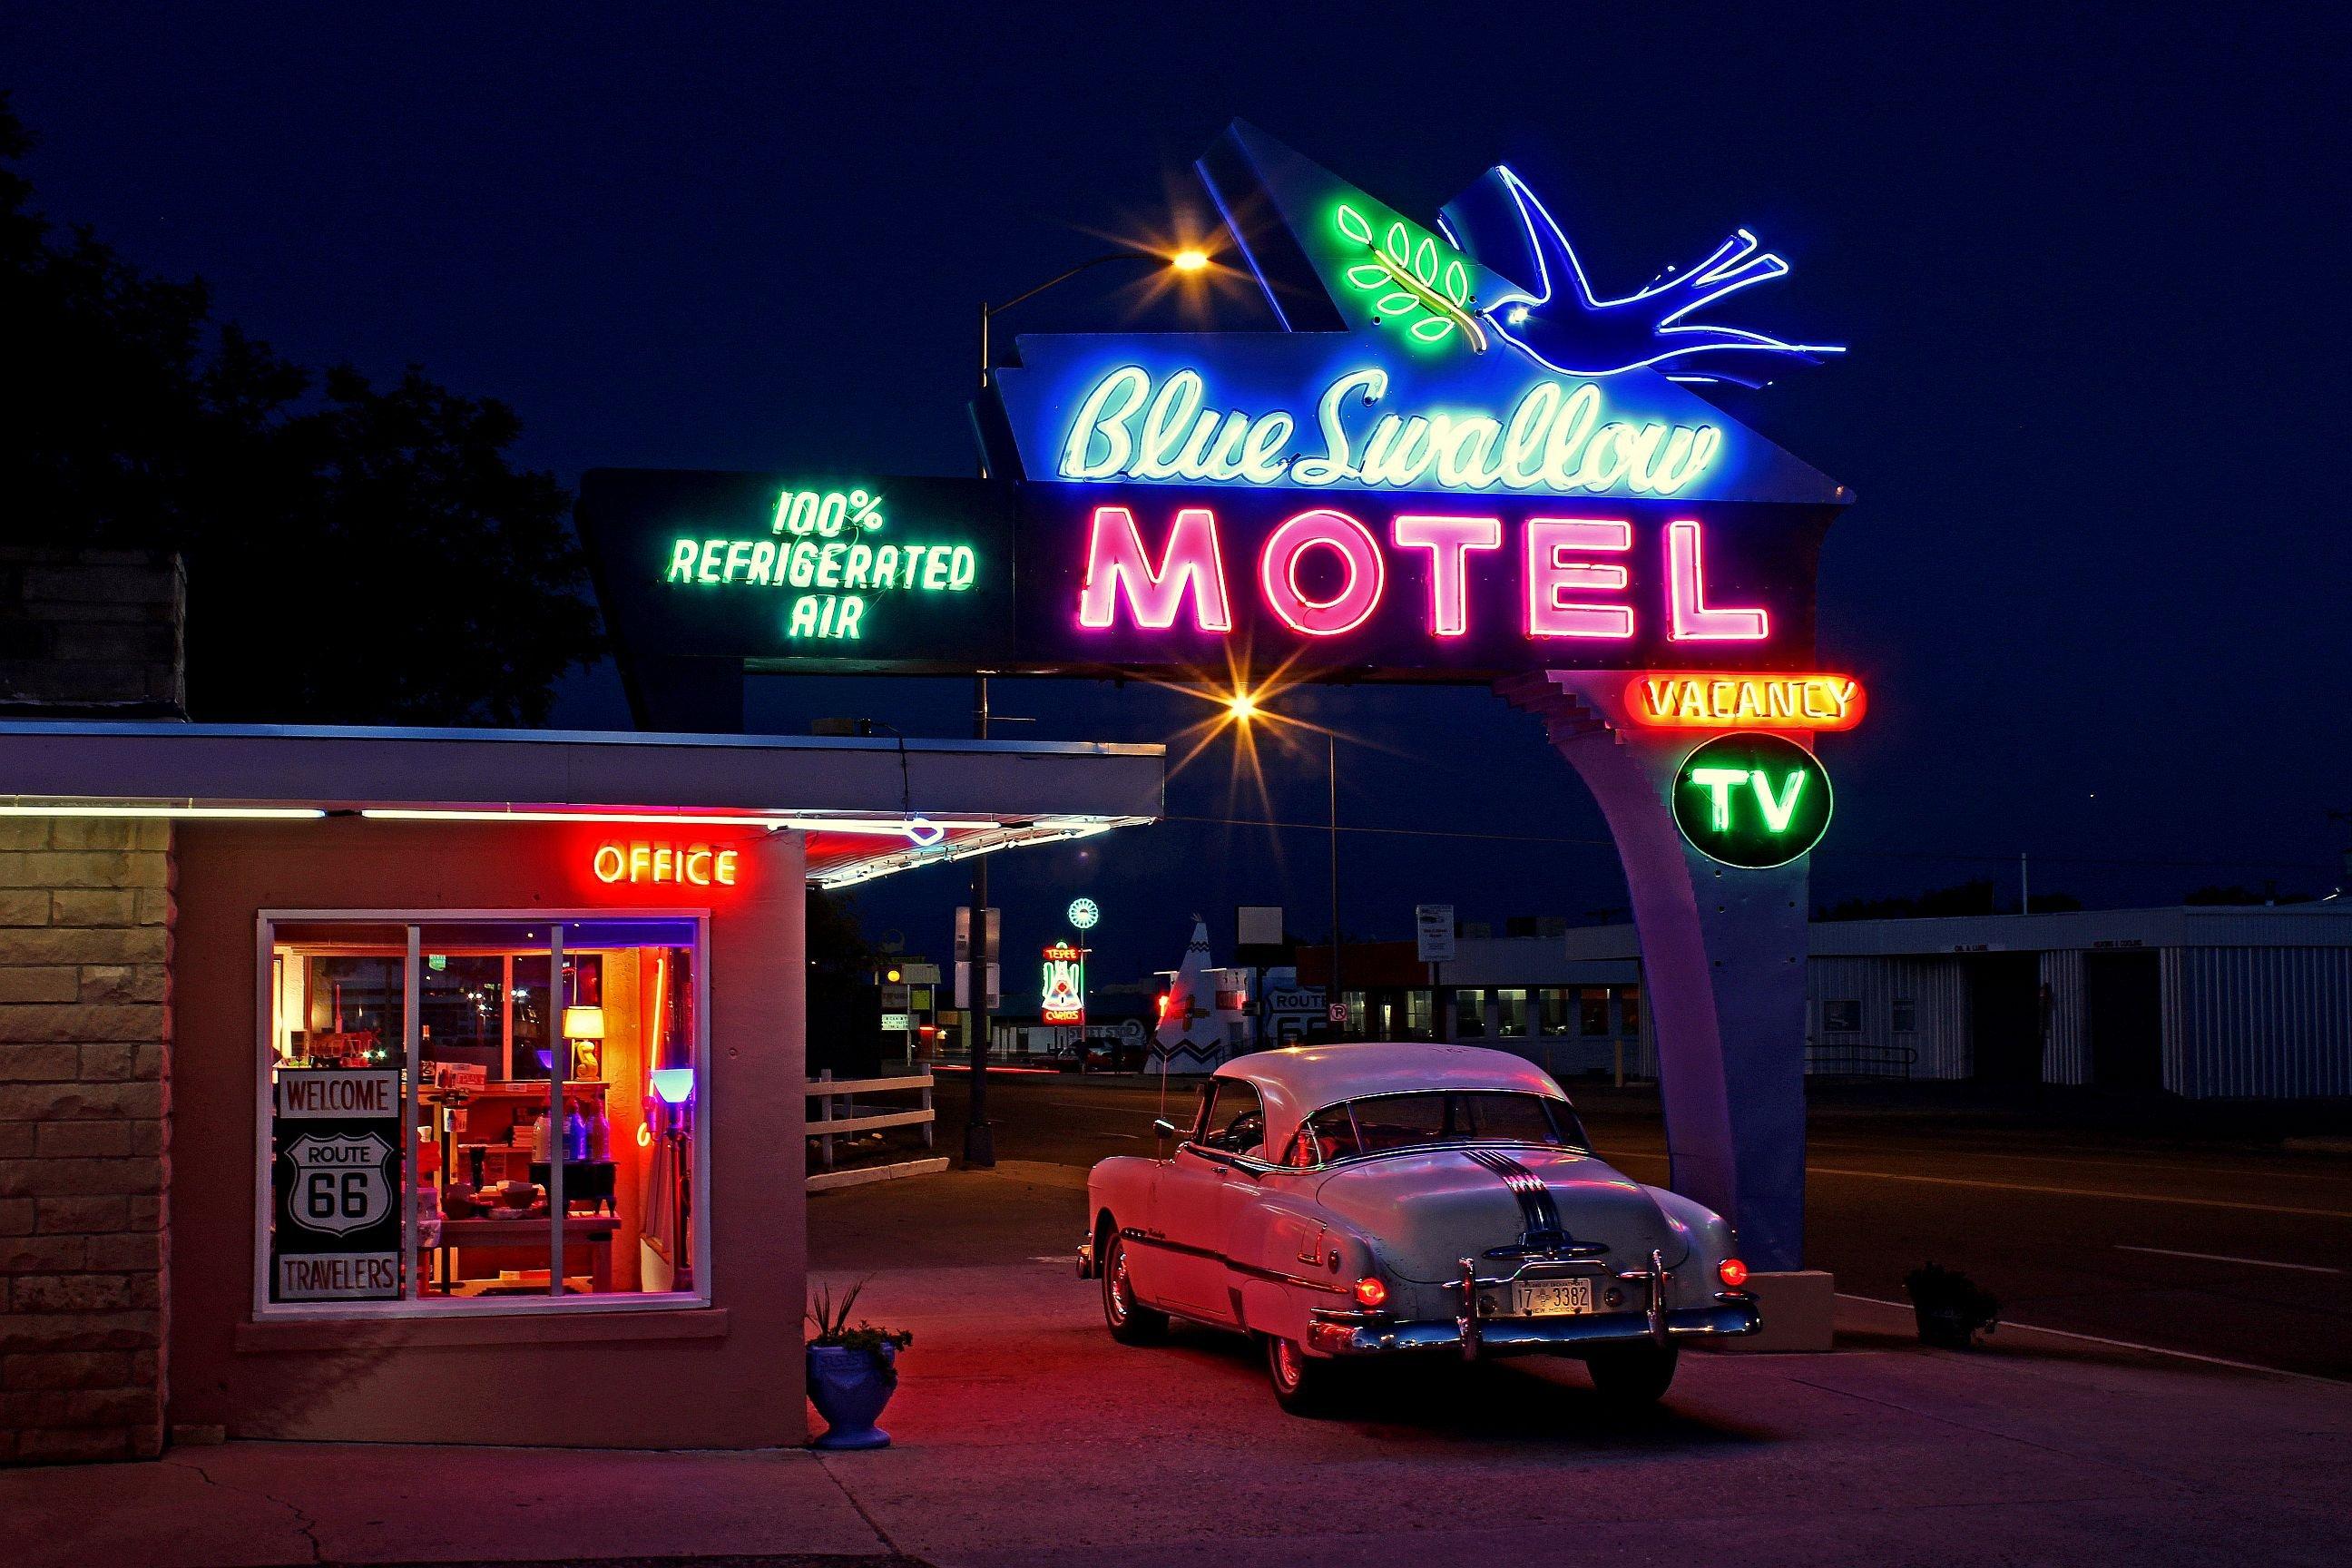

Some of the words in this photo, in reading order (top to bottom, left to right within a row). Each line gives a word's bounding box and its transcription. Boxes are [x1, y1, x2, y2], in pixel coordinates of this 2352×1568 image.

[1056, 365, 1295, 483] Blue
[1289, 368, 1722, 495] Swallow
[771, 488, 884, 537] 100%
[667, 539, 976, 591] REFRIGERATED
[1079, 507, 1770, 640] MOTEL
[789, 593, 865, 640] AIR
[1641, 680, 1856, 718] VACANCY
[1690, 769, 1807, 833] TV
[593, 844, 739, 886] OFFICE
[1045, 948, 1077, 959] TEPEE
[1045, 1010, 1079, 1021] CURIOS
[286, 1079, 390, 1112] WELCOME
[308, 1146, 371, 1163] ROUTE
[308, 1172, 368, 1218] 66
[284, 1259, 395, 1290] TRAVELERS
[1518, 1289, 1533, 1308] 17
[1553, 1287, 1588, 1307] 3382
